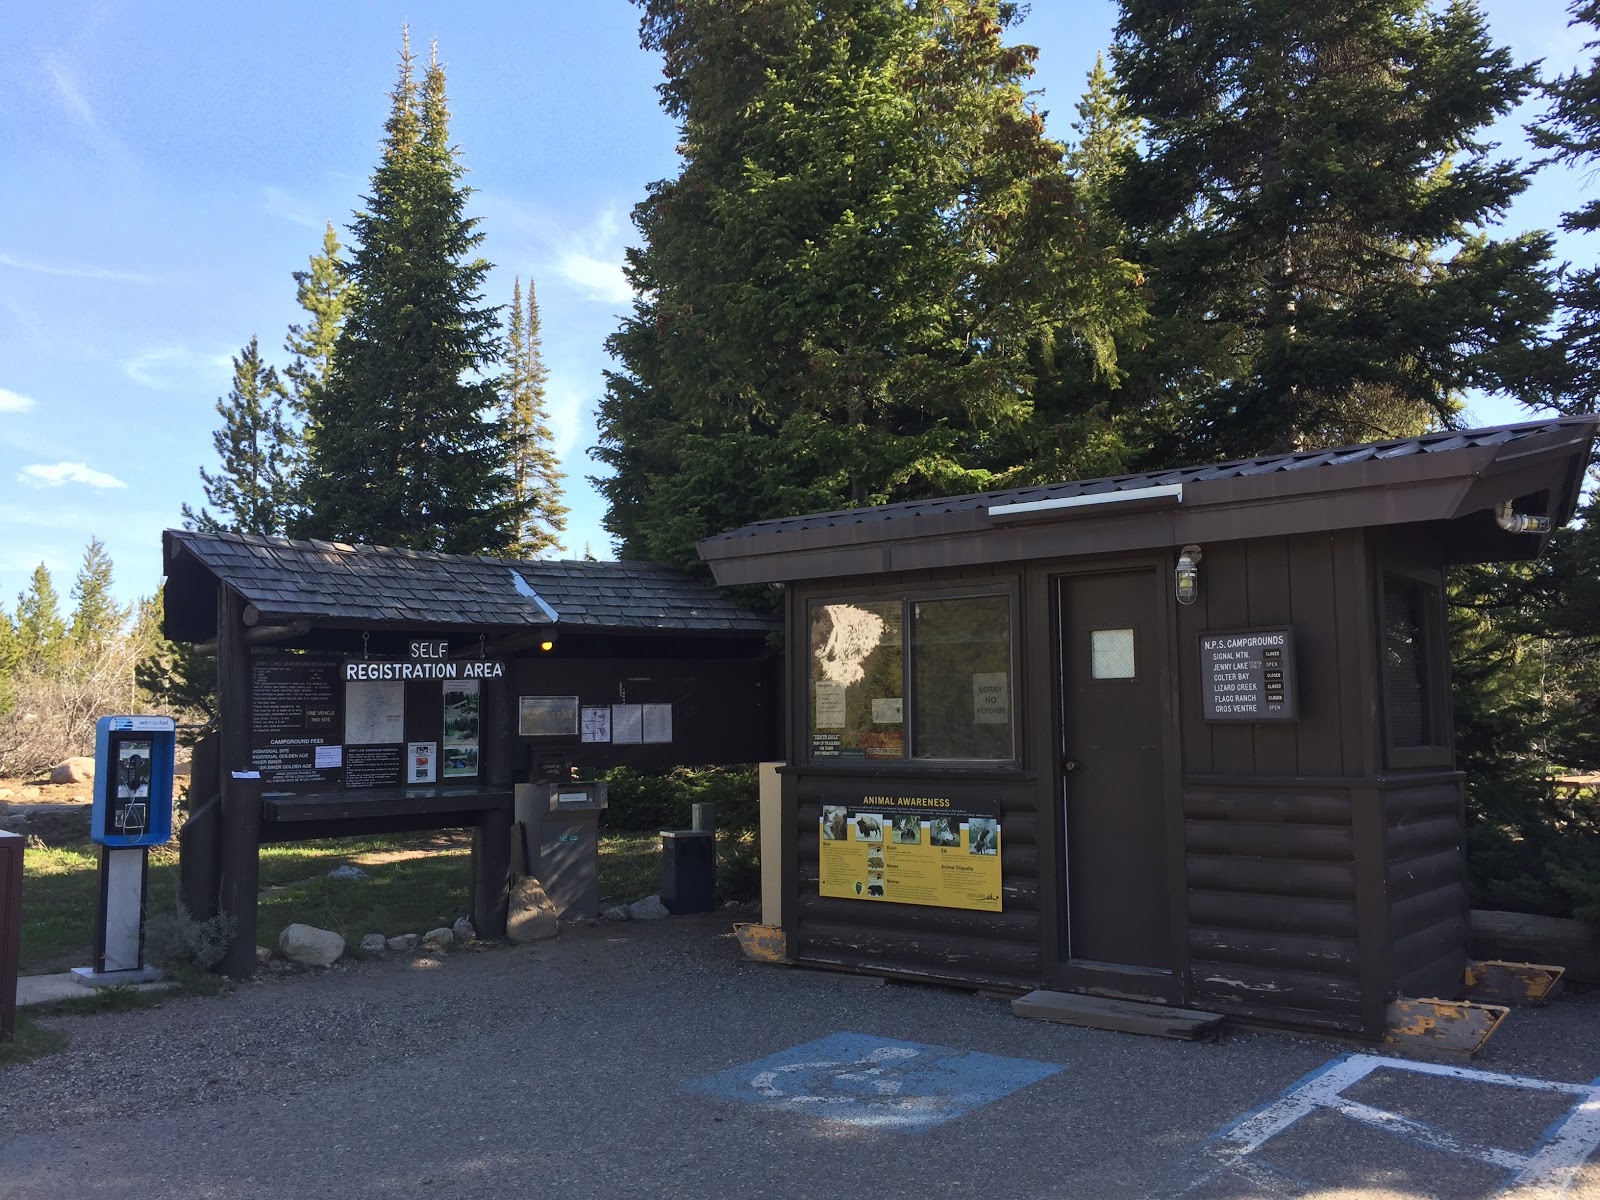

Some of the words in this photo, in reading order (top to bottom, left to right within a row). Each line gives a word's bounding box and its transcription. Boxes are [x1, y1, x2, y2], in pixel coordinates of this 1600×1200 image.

[1204, 640, 1227, 650] N.P.S.
[1227, 635, 1284, 648] CAMPGROUNDS
[411, 642, 448, 658] SELF
[1213, 652, 1234, 660] SIGNAL
[1235, 651, 1251, 659] MTN.
[346, 663, 456, 680] REGISTRATION
[463, 662, 503, 678] AREA
[1213, 663, 1232, 671] JENNY
[1233, 662, 1249, 670] LAKE
[1213, 673, 1237, 681] COLTER
[1237, 672, 1250, 680] BAY
[978, 686, 1002, 694] SORRY
[1214, 684, 1236, 692] LIZARD
[1236, 683, 1258, 691] CREEK
[1214, 695, 1235, 703] FLAGG
[1235, 694, 1257, 702] RANCH
[1215, 705, 1232, 713] GROS
[1233, 704, 1257, 712] VENTRE
[863, 796, 895, 806] ANIMAL
[897, 797, 951, 808] AWARENESS
